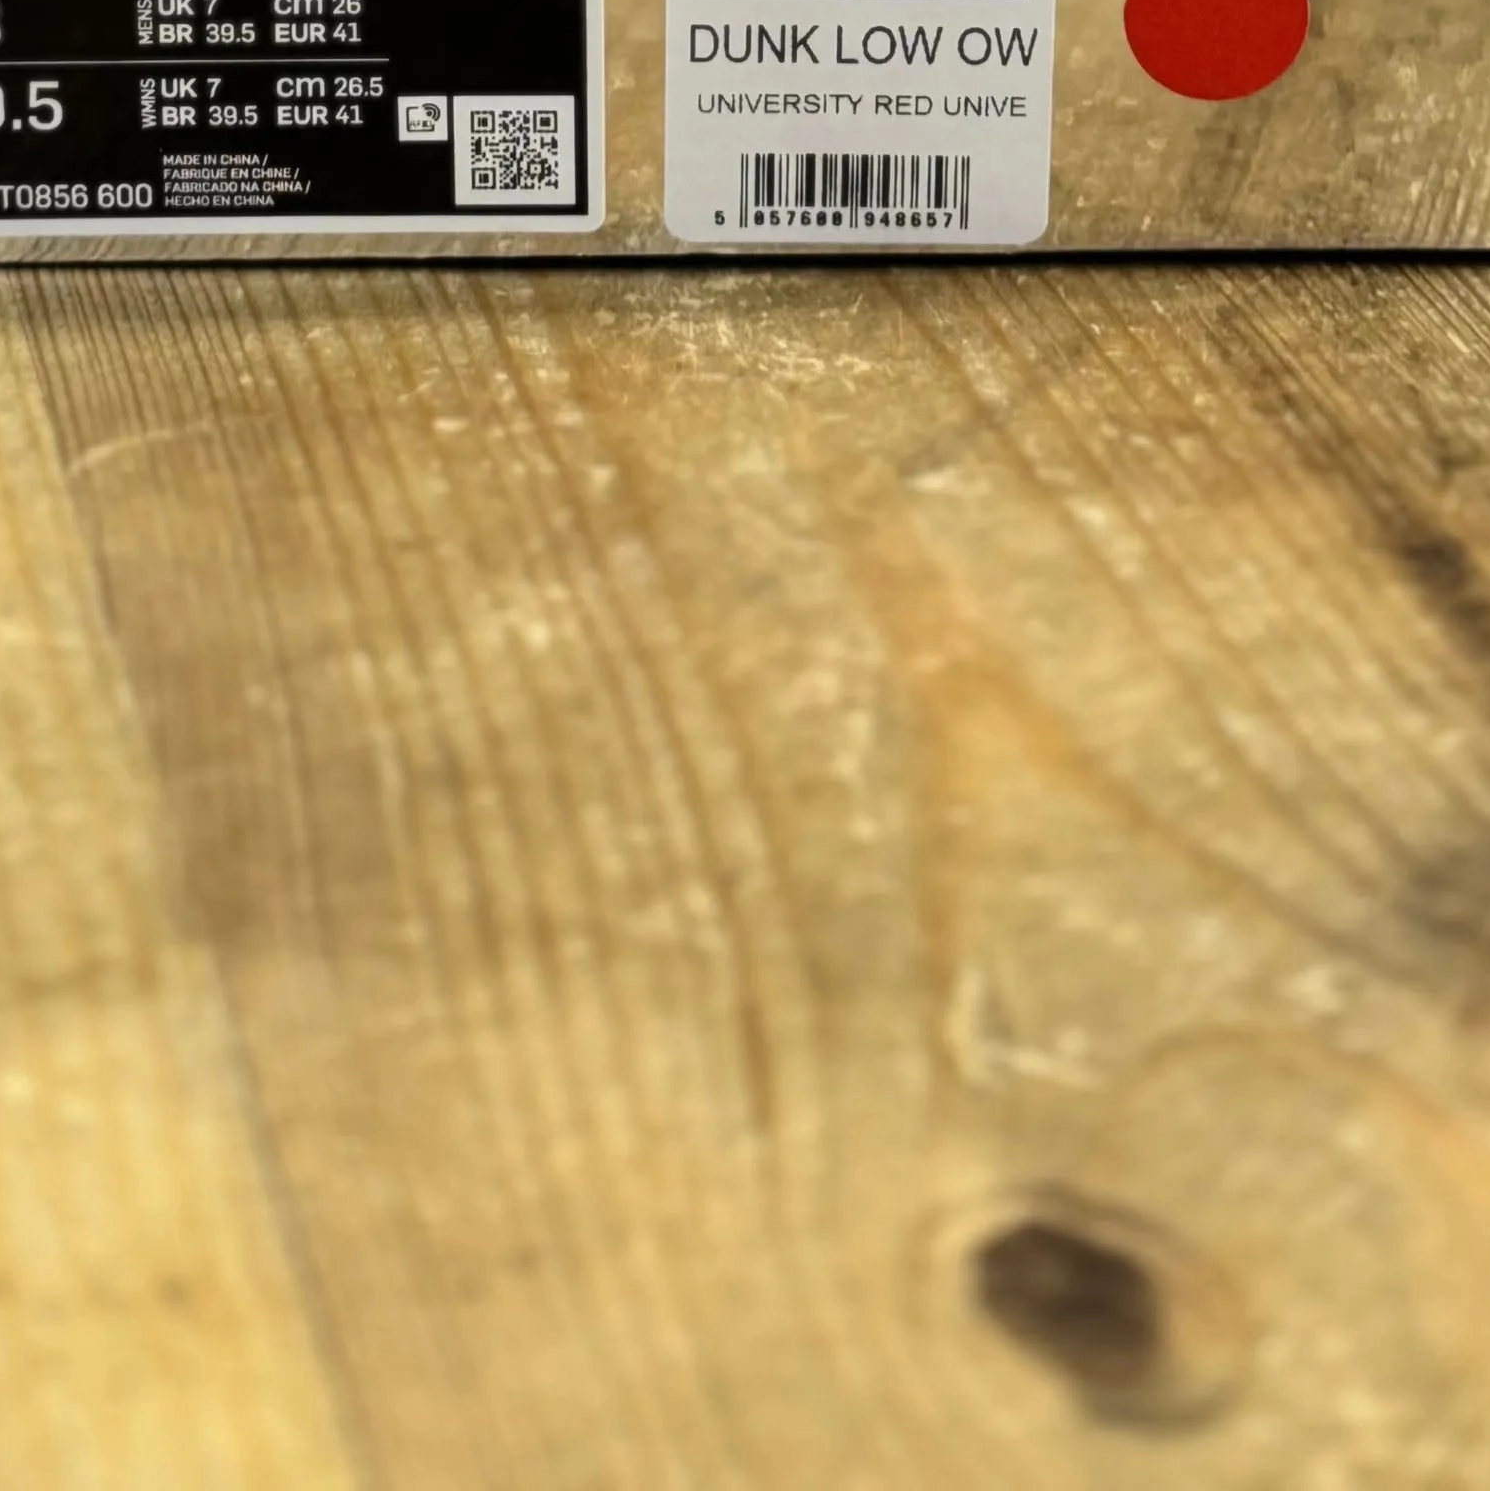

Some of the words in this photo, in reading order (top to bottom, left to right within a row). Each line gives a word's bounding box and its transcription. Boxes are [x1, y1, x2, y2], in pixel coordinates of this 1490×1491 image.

[138, 0, 153, 44] MENS
[159, 24, 192, 43] BR
[206, 23, 255, 43] 39.5
[275, 23, 325, 42] EUR
[333, 23, 361, 42] 41
[690, 24, 819, 63] DUNK
[837, 25, 943, 65] LOW
[958, 27, 1037, 66] OW
[161, 78, 197, 98] UK
[207, 78, 221, 97] 7
[277, 78, 325, 97] cm
[334, 77, 383, 96] 26.5
[140, 78, 156, 128] WMNS
[698, 94, 862, 114] UNIVERSITY
[875, 95, 933, 115] RED
[944, 96, 1026, 116] UNIVE
[162, 106, 196, 125] BR
[209, 106, 257, 125] 39.5
[278, 106, 328, 125] EUR
[336, 105, 363, 124] 41
[163, 155, 200, 165] MADE
[204, 155, 216, 165] IN
[220, 155, 259, 165] CHINA
[262, 155, 268, 166] /
[164, 168, 227, 179] FABRIQUE
[231, 168, 248, 178] EN
[252, 168, 290, 178] CHINE
[294, 168, 299, 179] /
[98, 183, 152, 208] 600
[165, 182, 237, 192] FABRICADO
[241, 182, 259, 192] NA
[263, 181, 302, 192] CHINA
[305, 181, 310, 193] /
[165, 196, 209, 206] HECHO
[213, 196, 230, 205] EN
[234, 195, 274, 206] CHINA
[715, 211, 725, 225] 5
